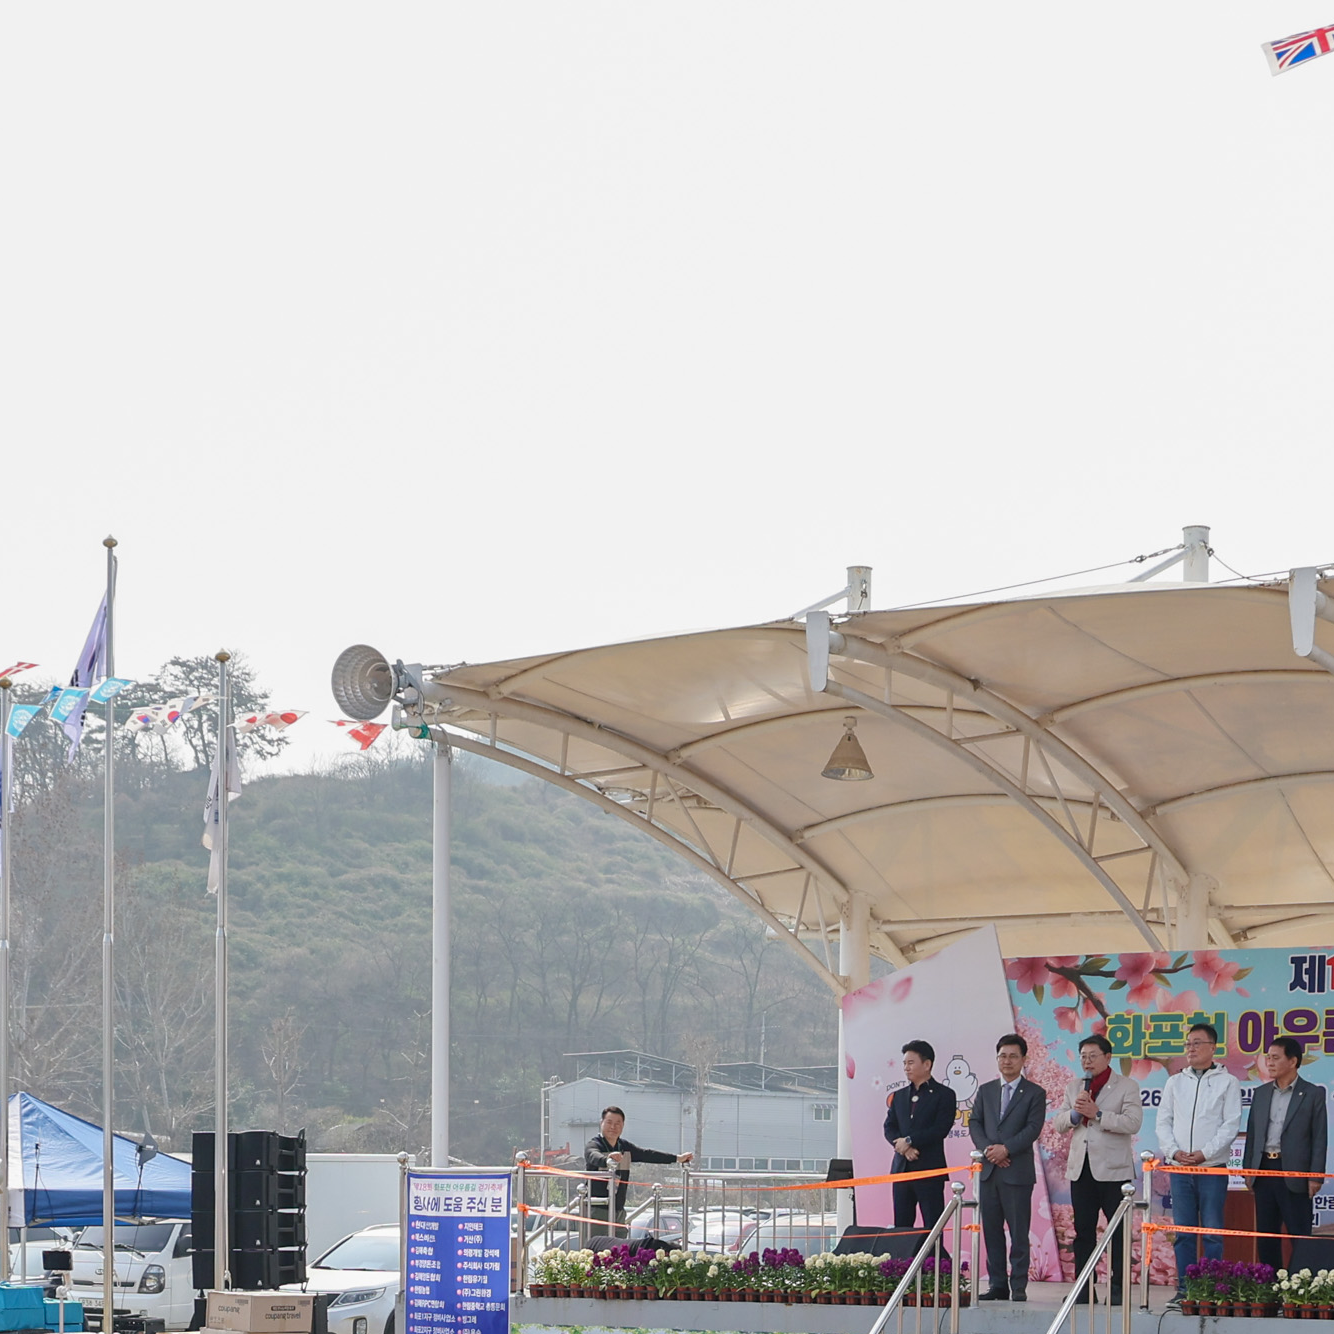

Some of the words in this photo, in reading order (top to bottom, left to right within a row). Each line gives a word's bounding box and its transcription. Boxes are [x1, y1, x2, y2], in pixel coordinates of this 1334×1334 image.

[443, 1197, 463, 1212] 도움
[467, 1197, 487, 1213] 주신
[491, 1197, 502, 1213] 분
[218, 1305, 240, 1314] coupang
[265, 1312, 286, 1321] coupang
